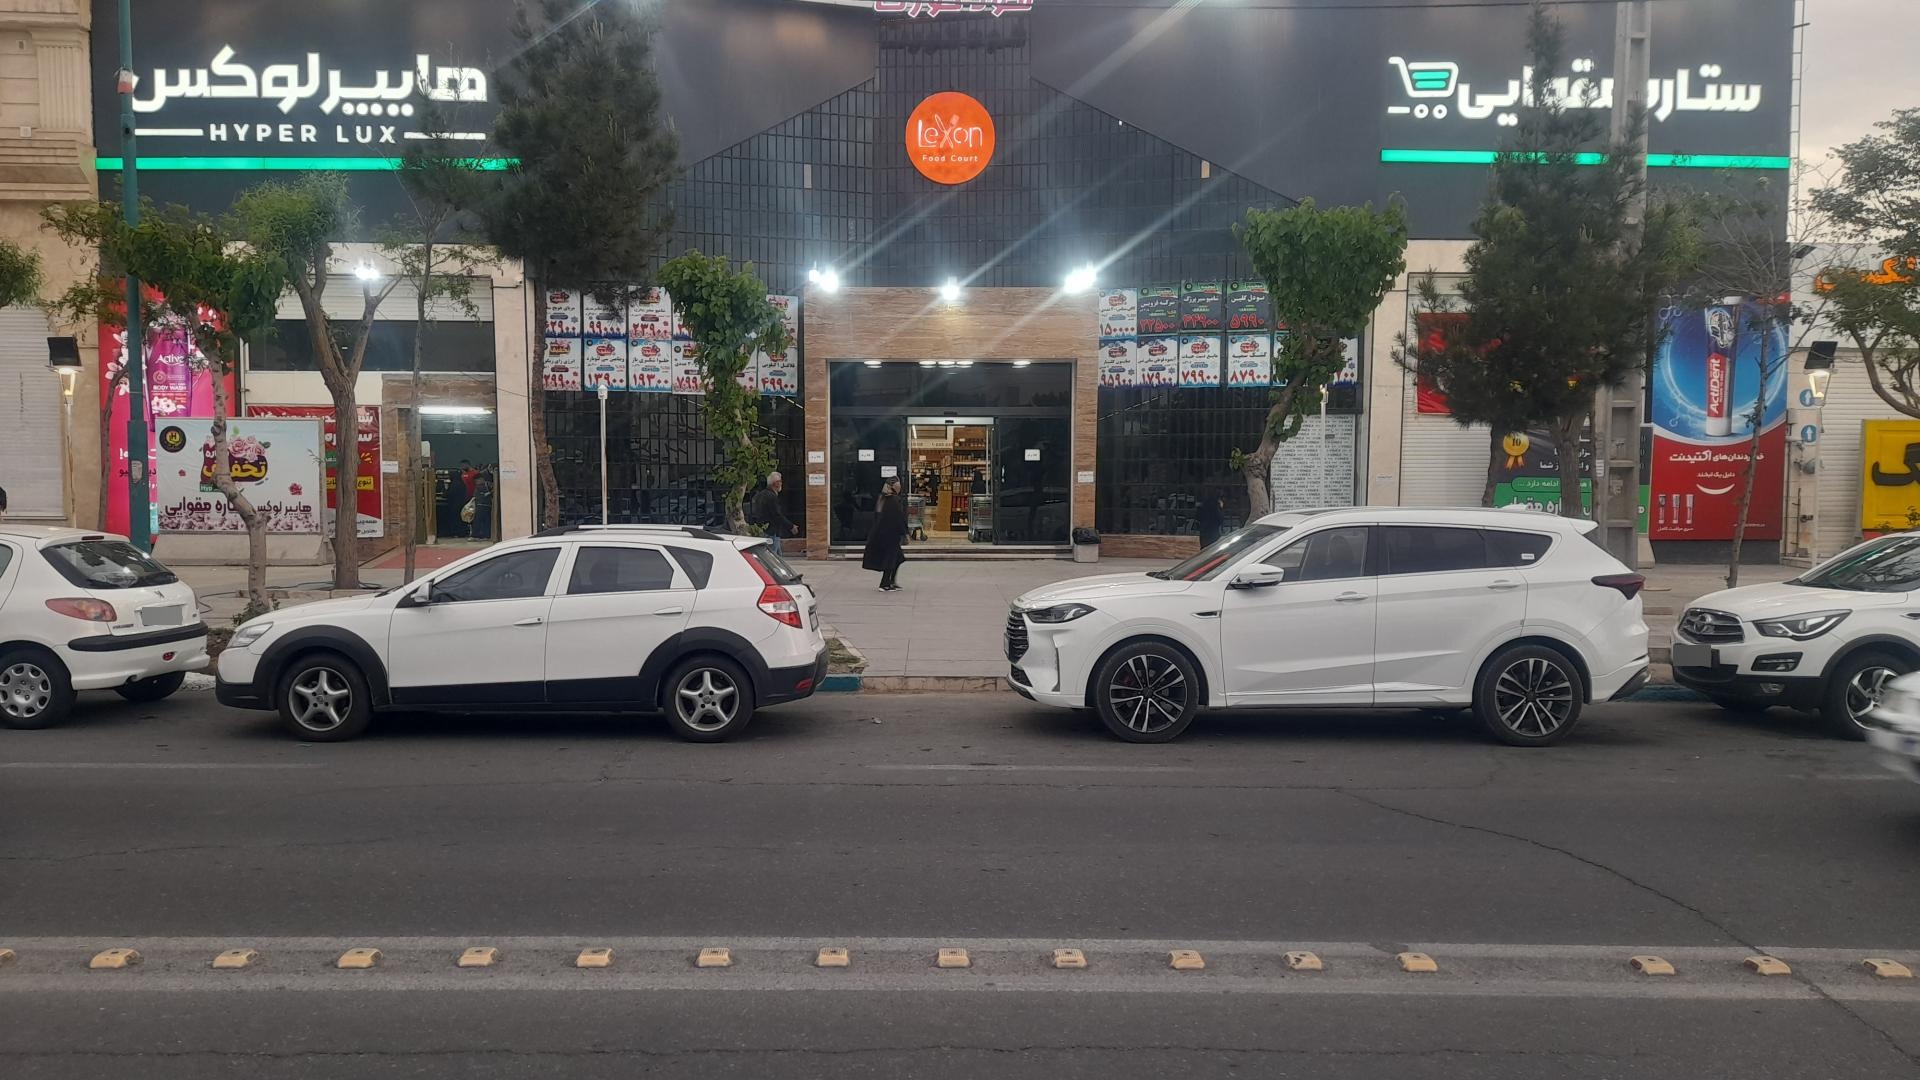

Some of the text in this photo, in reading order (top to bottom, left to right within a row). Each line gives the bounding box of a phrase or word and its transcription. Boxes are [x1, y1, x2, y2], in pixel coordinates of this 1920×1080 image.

[132, 45, 488, 117] هایپر لوکس
[210, 123, 397, 145] HYPER LUX
[922, 154, 979, 162] Food Court
[676, 375, 698, 390] ۷۹۹
[203, 460, 267, 478] تخفف
[164, 495, 212, 517] مقوایی
[215, 498, 240, 516] اره
[284, 500, 312, 516] هایپر
[1546, 497, 1562, 513] اره
